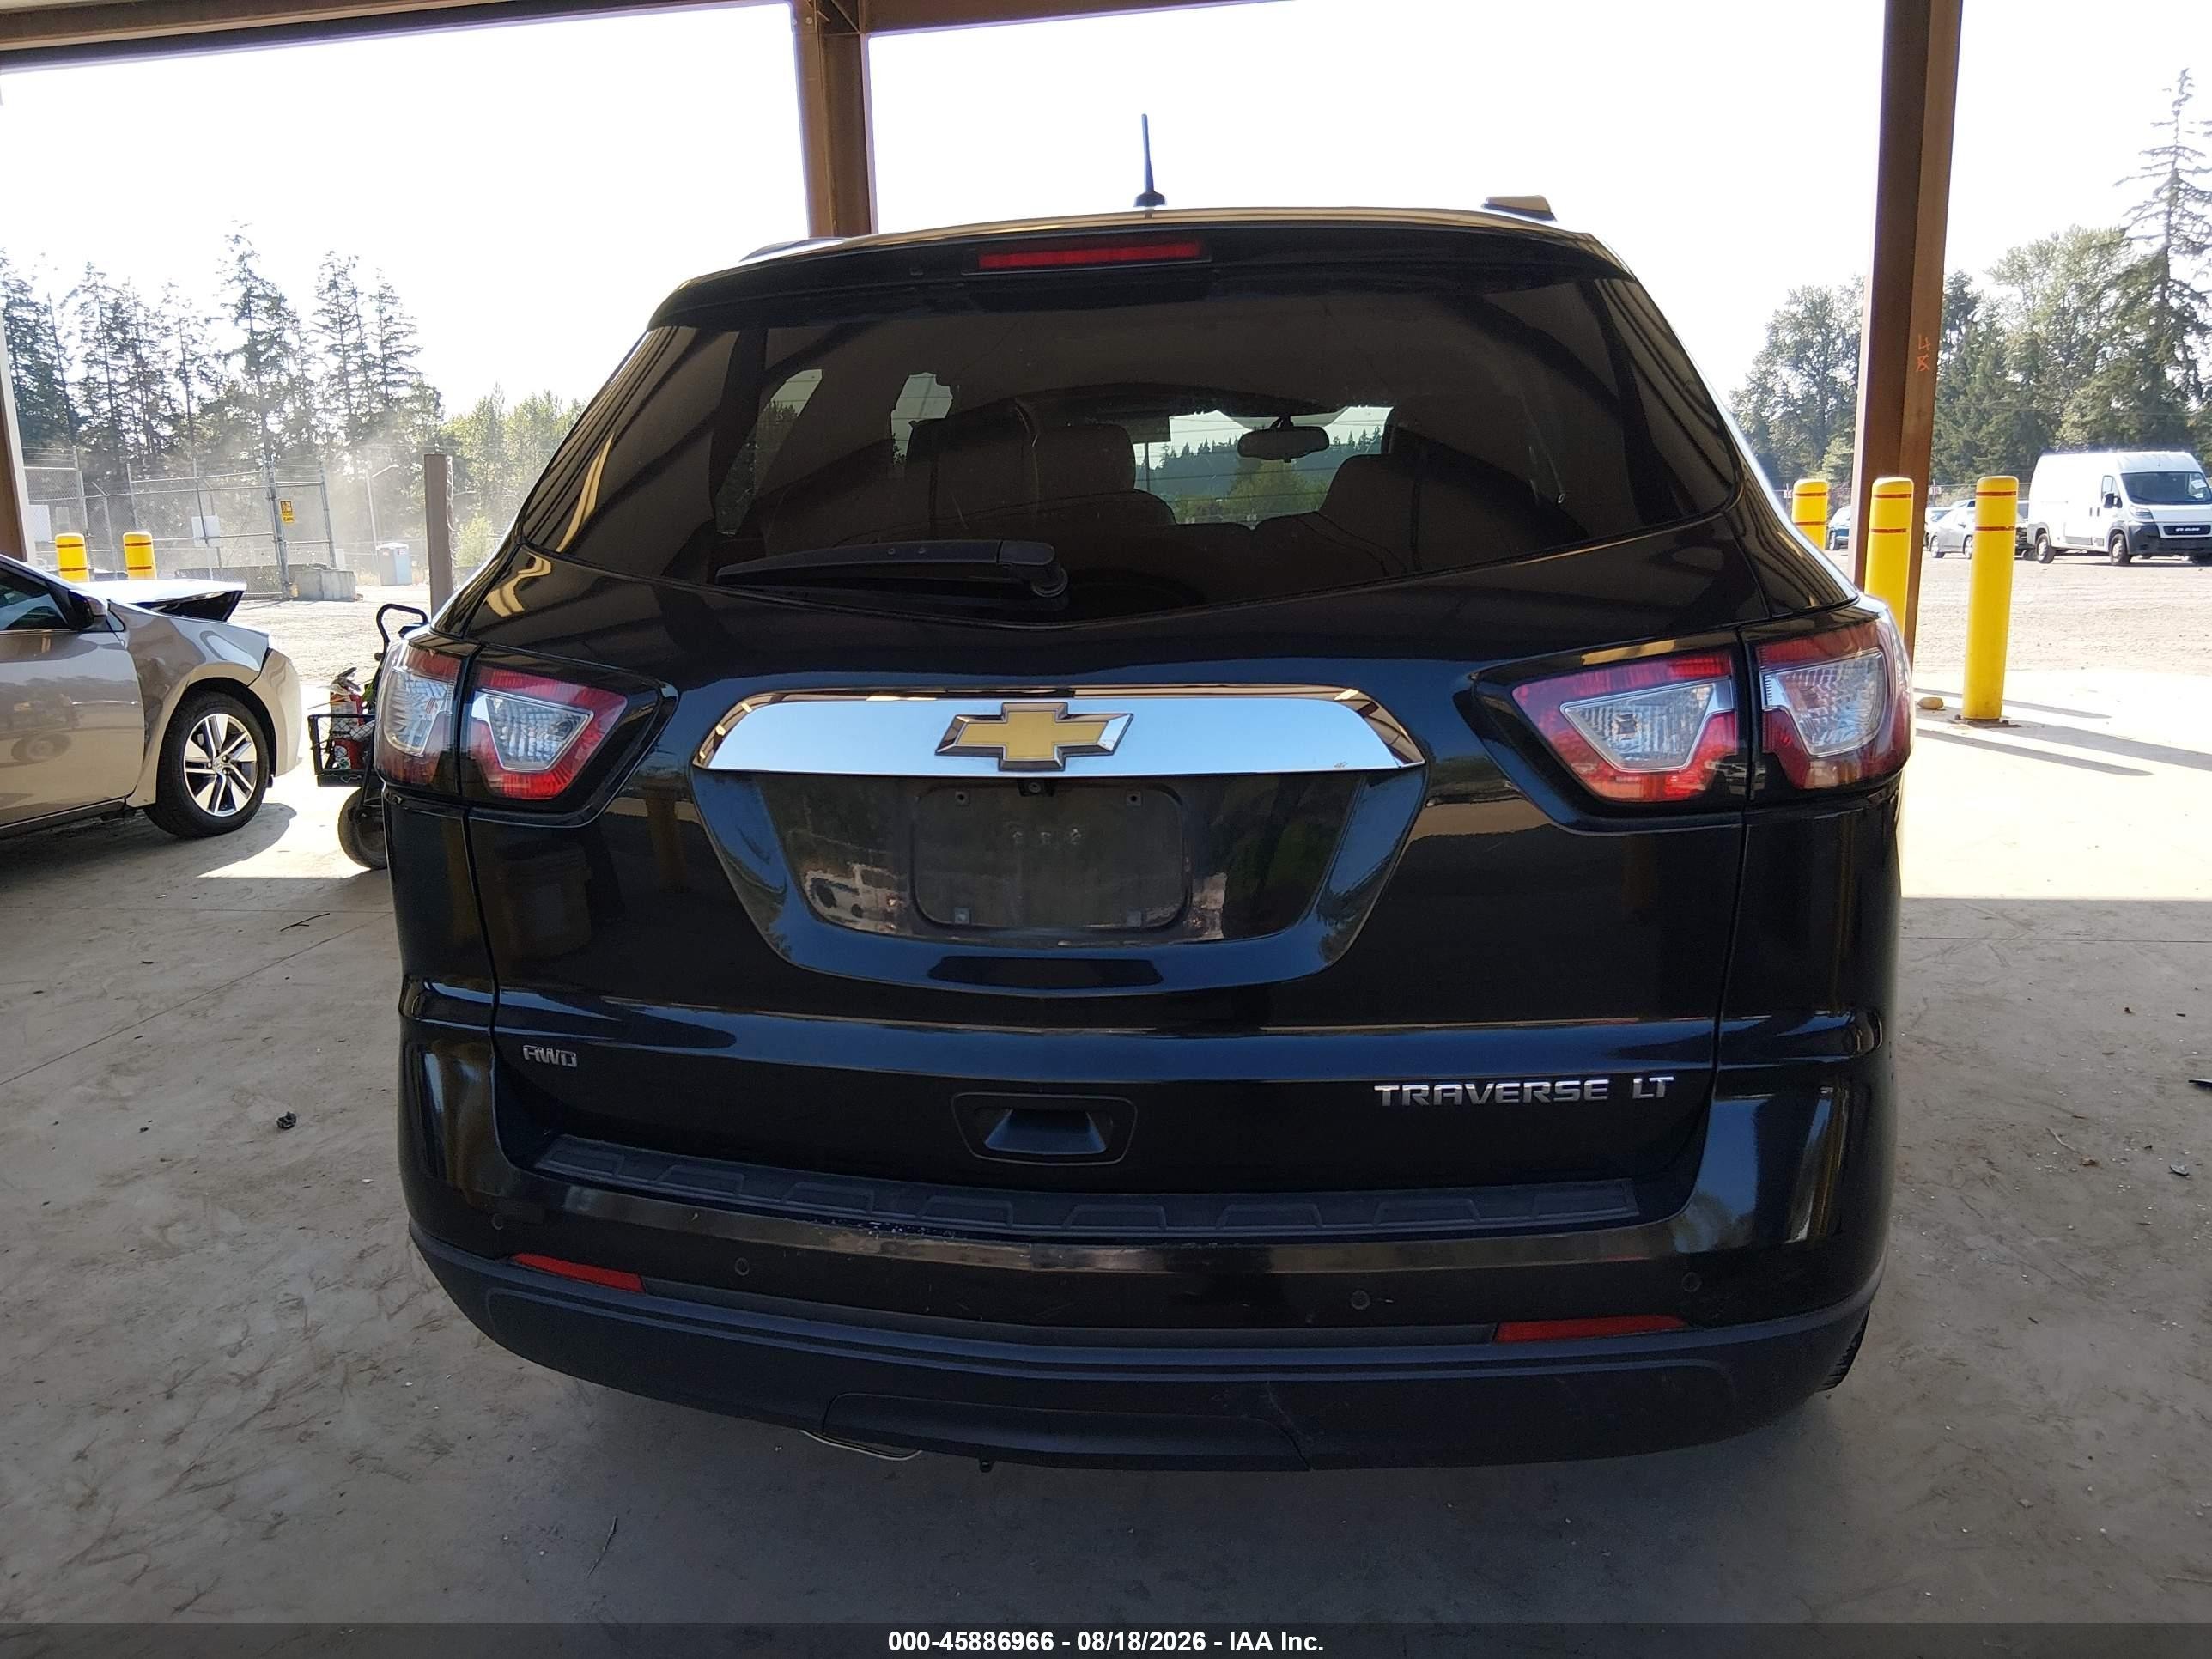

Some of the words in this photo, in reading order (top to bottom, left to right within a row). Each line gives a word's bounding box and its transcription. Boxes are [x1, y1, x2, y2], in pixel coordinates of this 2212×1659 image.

[523, 1044, 577, 1067] AWD
[1374, 1079, 1609, 1107] TRAVERSE
[1632, 1076, 1674, 1099] LT
